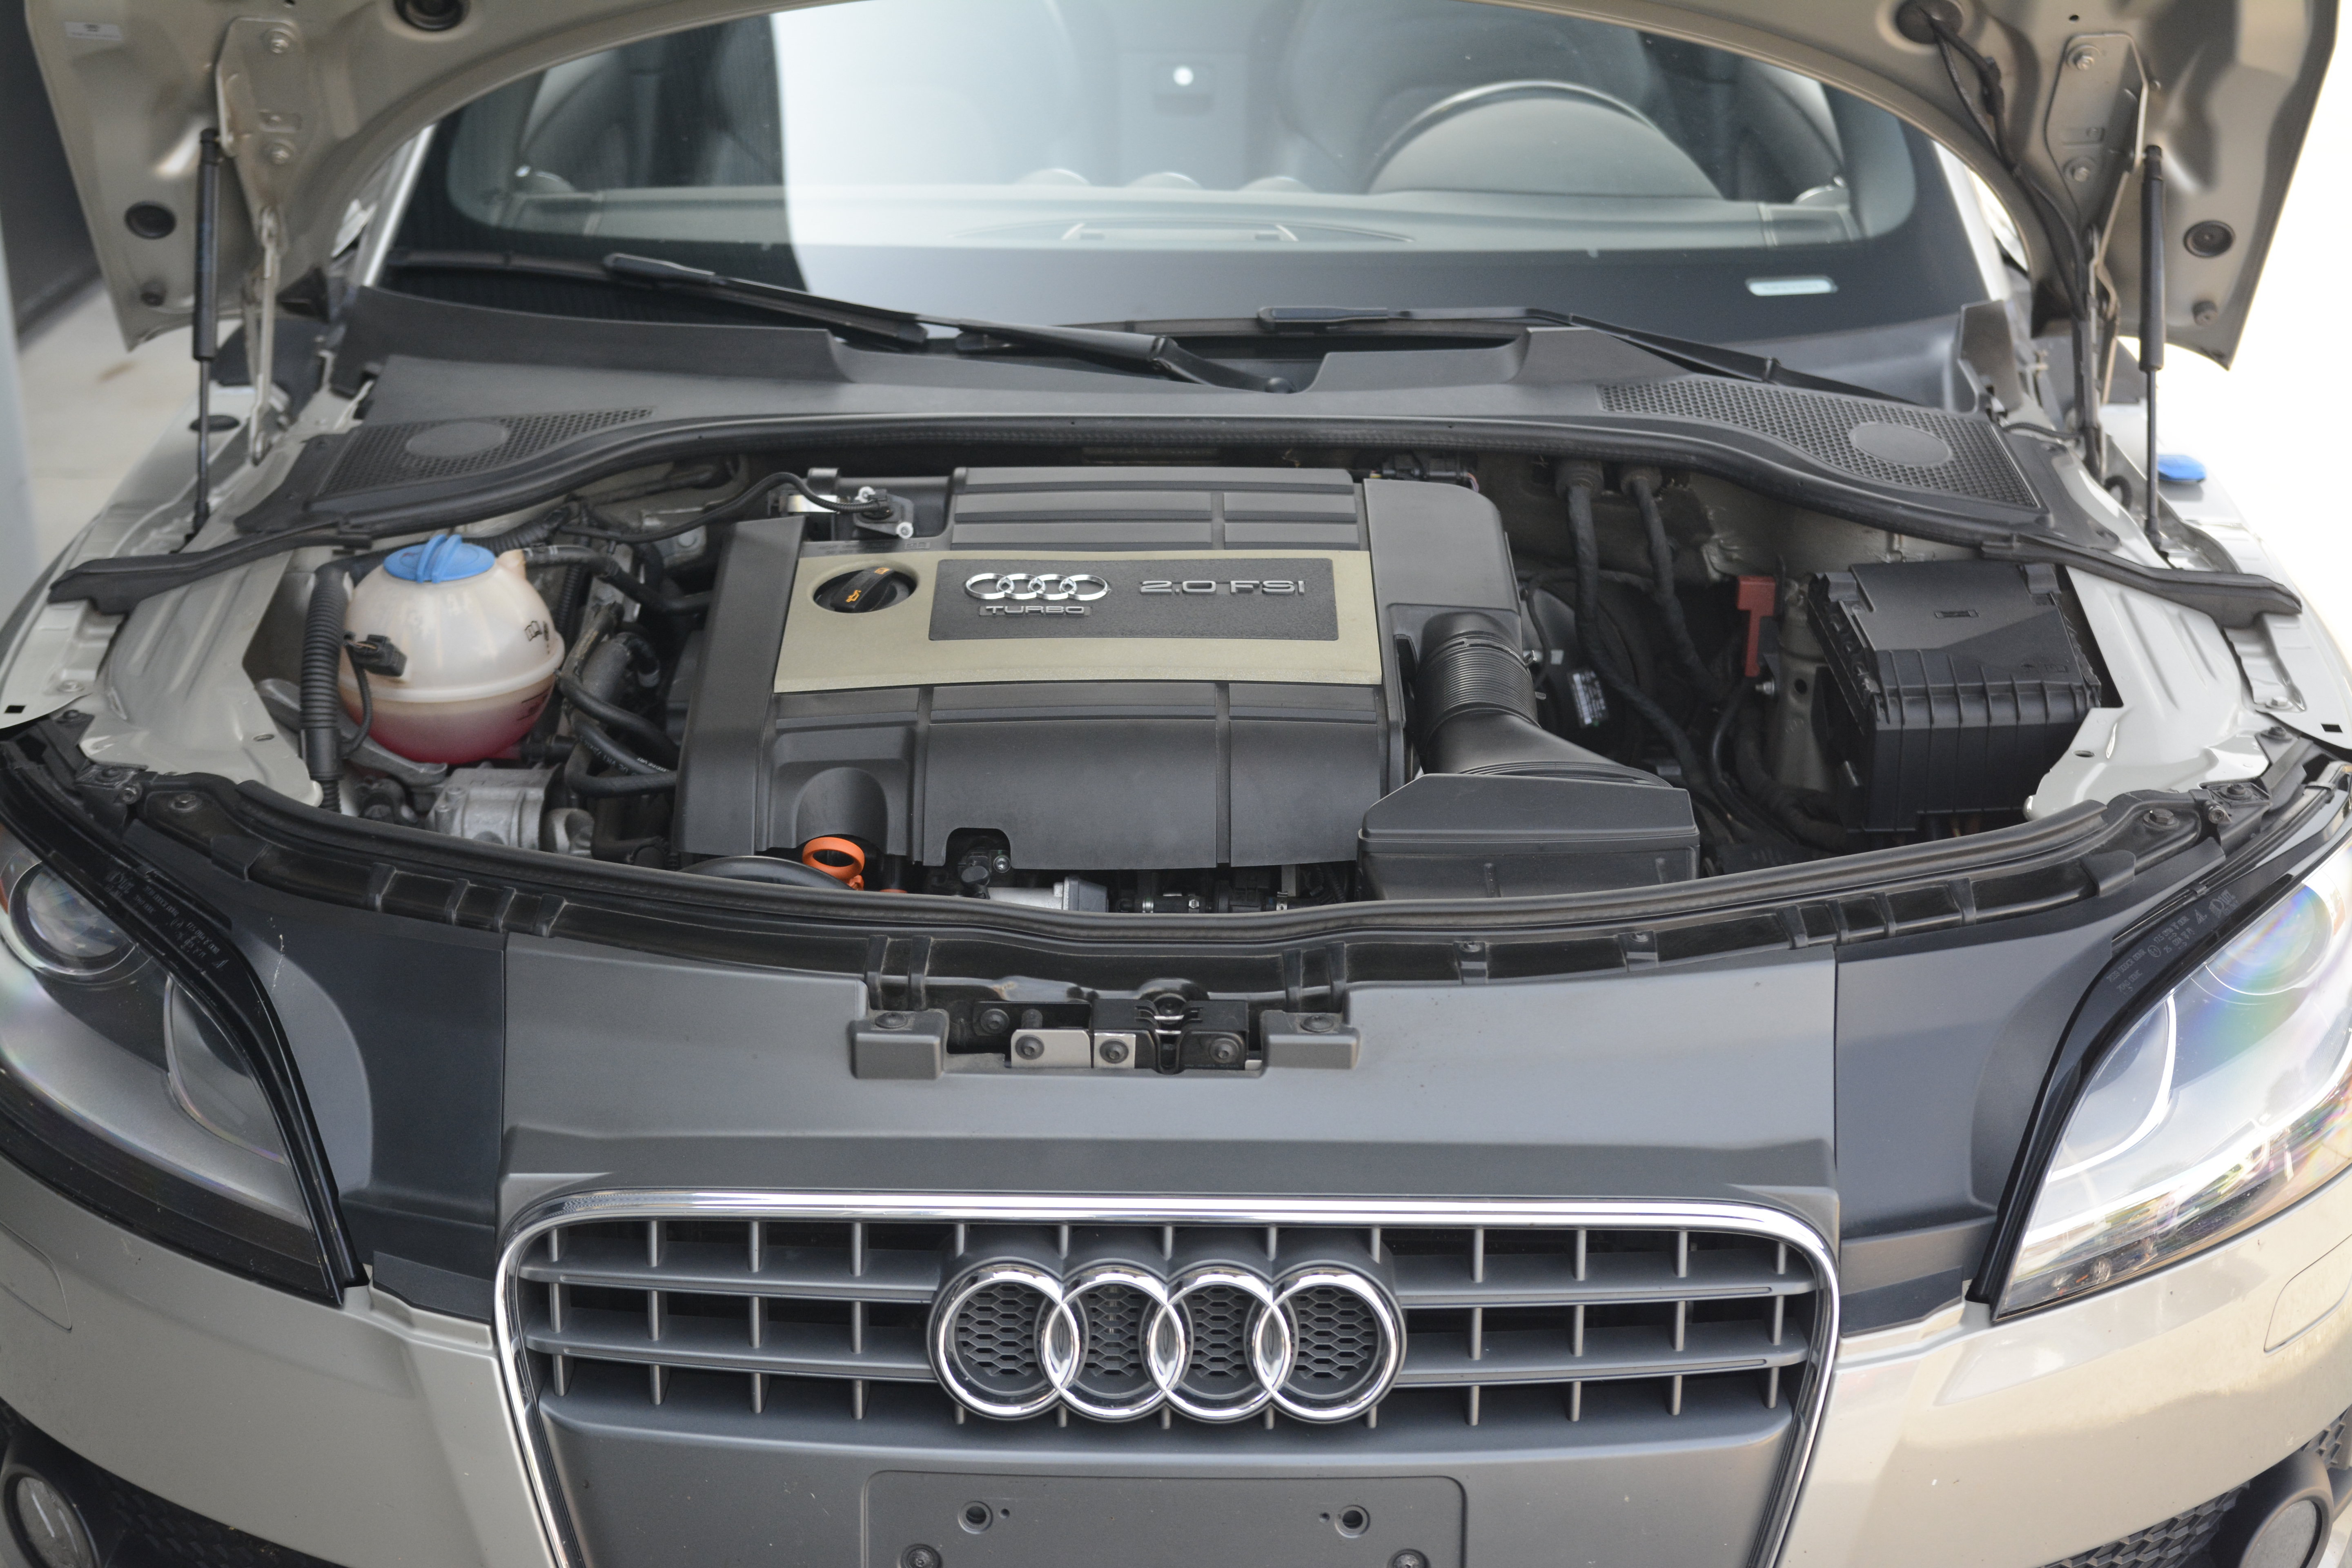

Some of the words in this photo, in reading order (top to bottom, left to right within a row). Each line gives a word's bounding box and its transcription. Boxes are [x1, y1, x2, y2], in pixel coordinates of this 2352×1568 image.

[1140, 580, 1216, 595] 2.0
[1229, 580, 1306, 595] FSI
[985, 606, 1085, 615] TURBO
